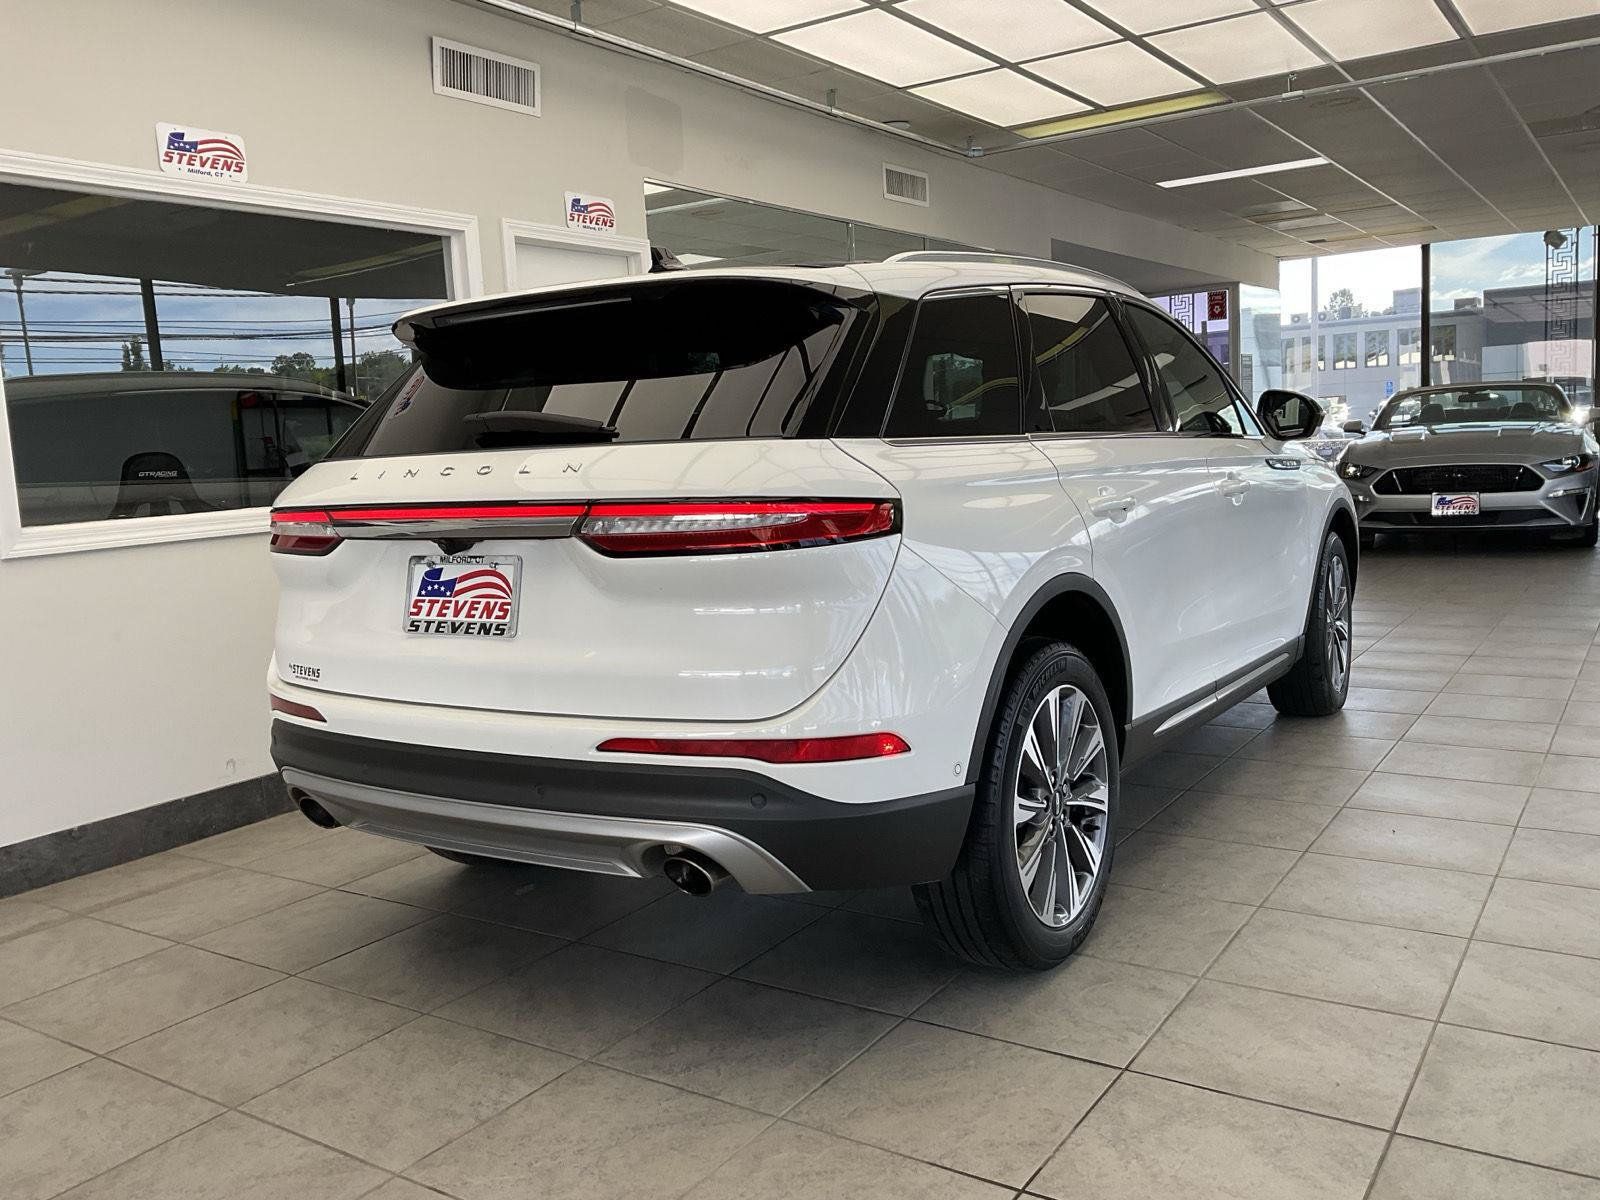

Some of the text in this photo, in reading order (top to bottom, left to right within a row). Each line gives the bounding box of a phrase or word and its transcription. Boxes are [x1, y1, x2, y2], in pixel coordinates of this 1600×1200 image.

[163, 151, 244, 173] STEVENS
[187, 168, 213, 177] Milford,
[569, 212, 615, 228] STEVENS
[349, 463, 583, 480] LINCOLN
[409, 599, 512, 620] STEVENS
[408, 620, 507, 636] STEVENS
[292, 664, 320, 678] STEVENS
